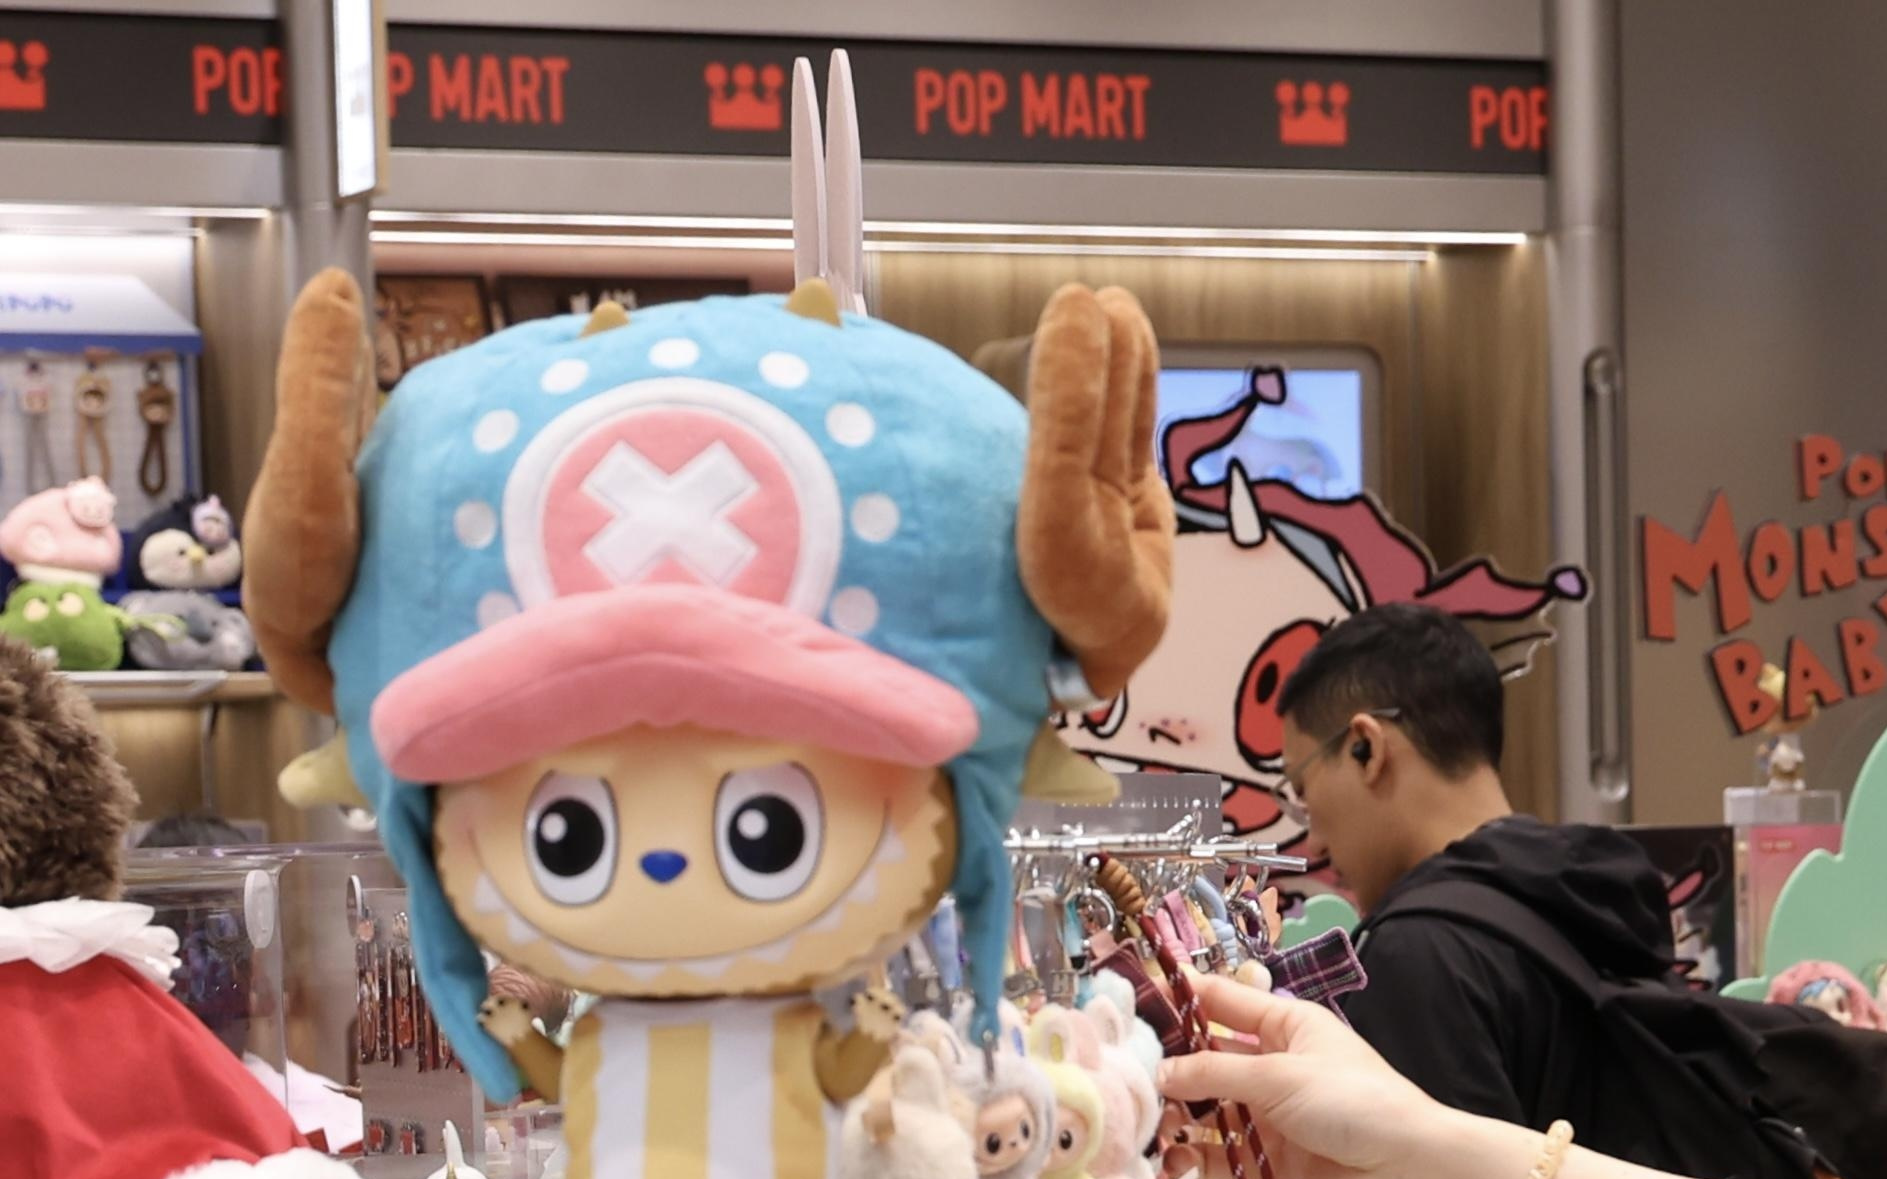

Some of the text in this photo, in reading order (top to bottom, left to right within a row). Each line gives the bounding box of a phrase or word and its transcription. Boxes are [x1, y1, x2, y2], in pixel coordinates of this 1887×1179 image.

[429, 53, 571, 124] MART
[915, 68, 1151, 141] POP MART
